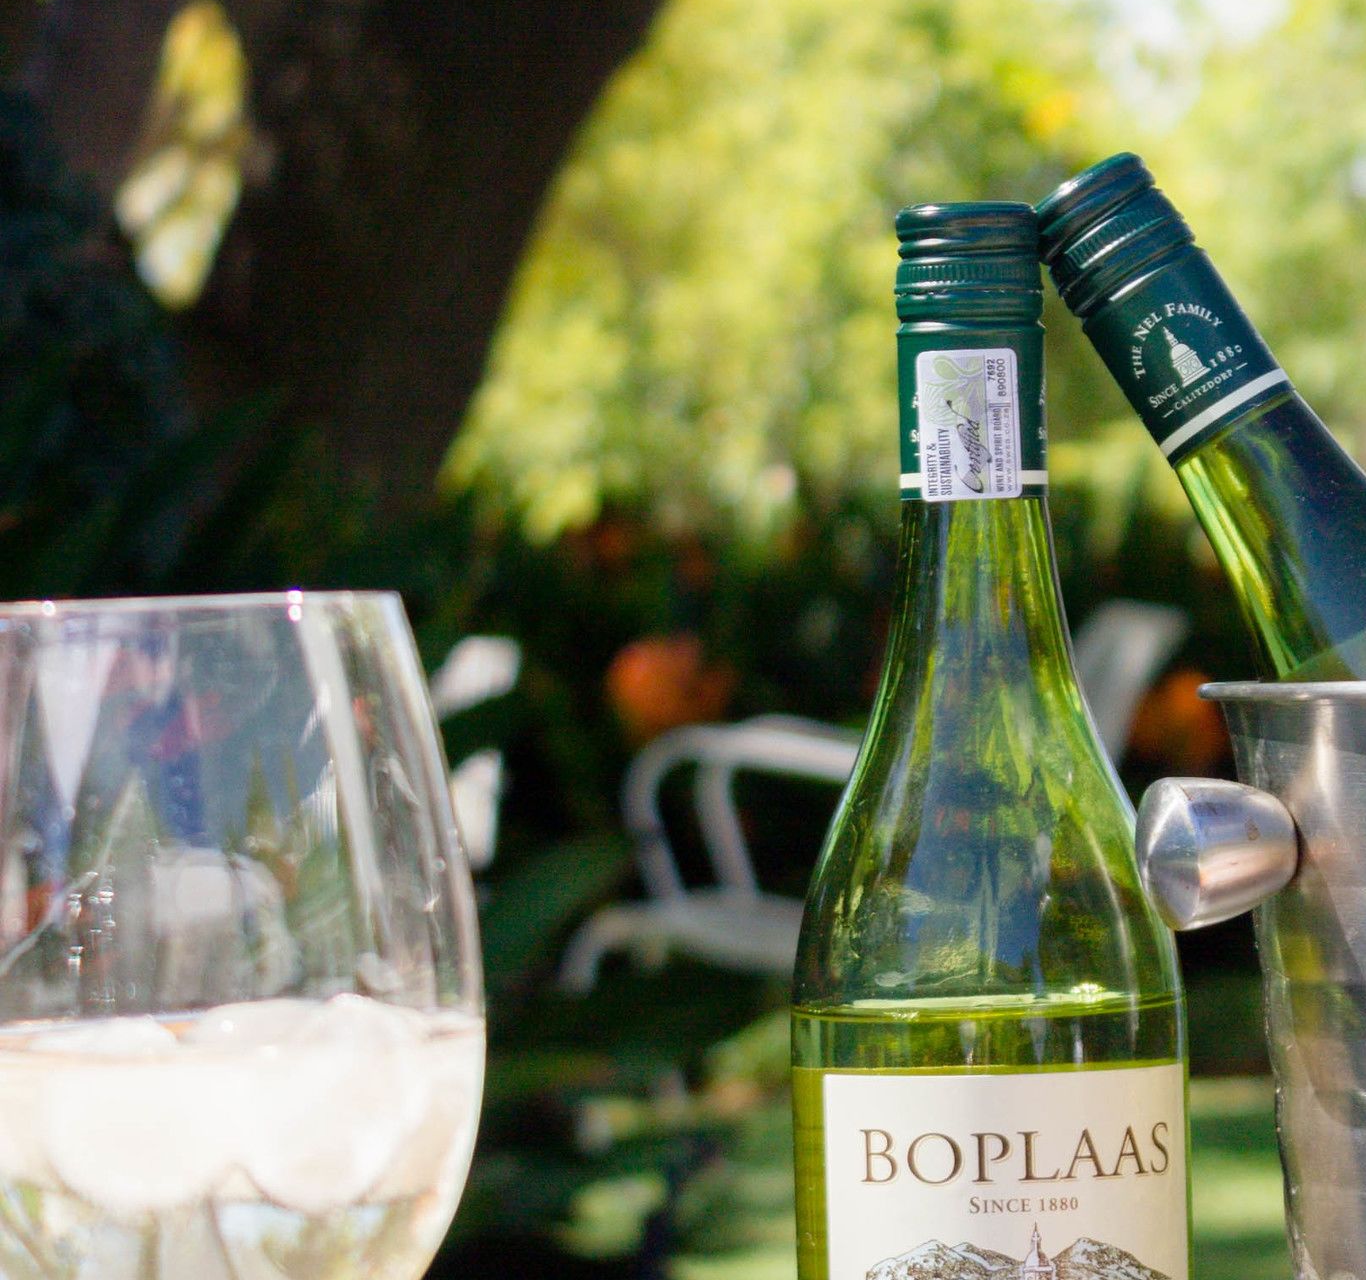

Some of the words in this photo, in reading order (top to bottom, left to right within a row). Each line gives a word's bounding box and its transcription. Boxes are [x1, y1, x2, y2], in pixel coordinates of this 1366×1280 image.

[1133, 312, 1162, 341] NEL
[1164, 302, 1223, 327] FAMILY
[987, 358, 996, 381] 7692
[997, 358, 1007, 397] 890800
[1131, 345, 1146, 379] THE
[1149, 383, 1179, 409] SINCE
[1209, 344, 1242, 368] 1880
[1174, 369, 1233, 410] CALITZDORP
[926, 443, 938, 451] &
[938, 428, 953, 496] SUSTAINABILITY
[946, 400, 992, 493] Certified
[994, 434, 1003, 456] SPIRIT
[926, 454, 939, 497] INTEGRITY
[995, 458, 1004, 472] AND
[859, 1121, 1169, 1185] BOPLAAS
[969, 1196, 1032, 1214] SINCE
[1039, 1196, 1079, 1212] 1880
